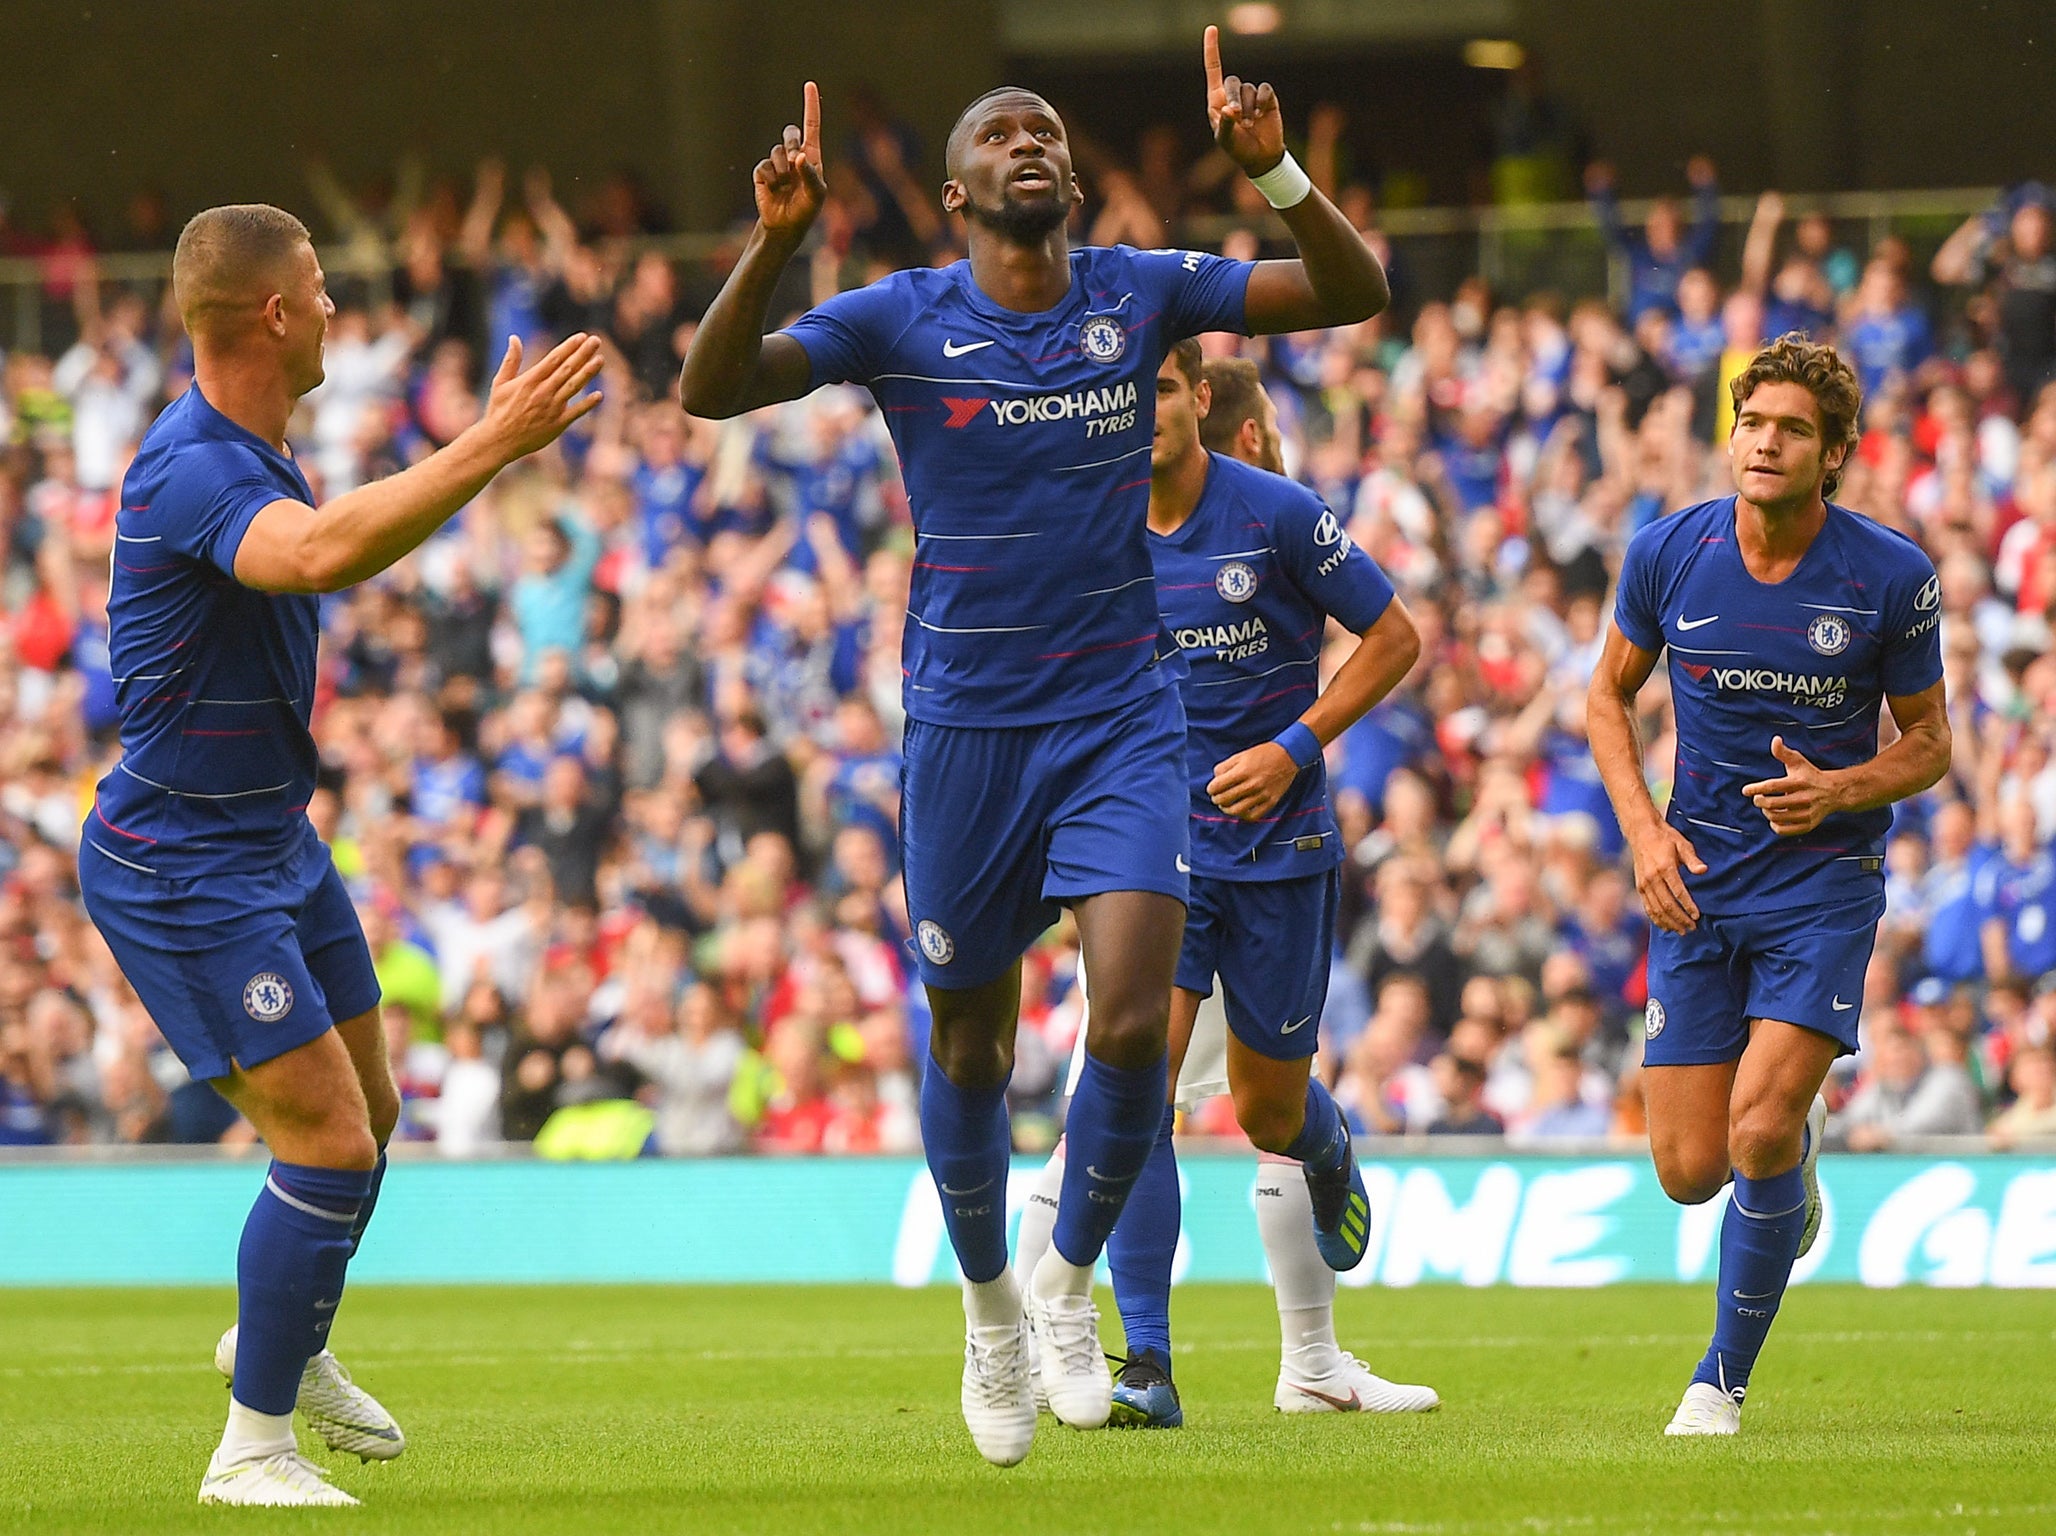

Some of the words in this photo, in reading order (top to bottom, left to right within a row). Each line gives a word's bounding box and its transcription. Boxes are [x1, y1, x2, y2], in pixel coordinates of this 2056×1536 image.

[989, 381, 1138, 426] YOKOHAMA
[1085, 408, 1136, 439] TYRES
[1169, 616, 1267, 649] KOHAMA
[1215, 636, 1268, 663] TYRES
[1711, 667, 1847, 696] YOKOHAMA
[1792, 689, 1844, 709] TYRES
[1736, 1306, 1767, 1318] CFC
